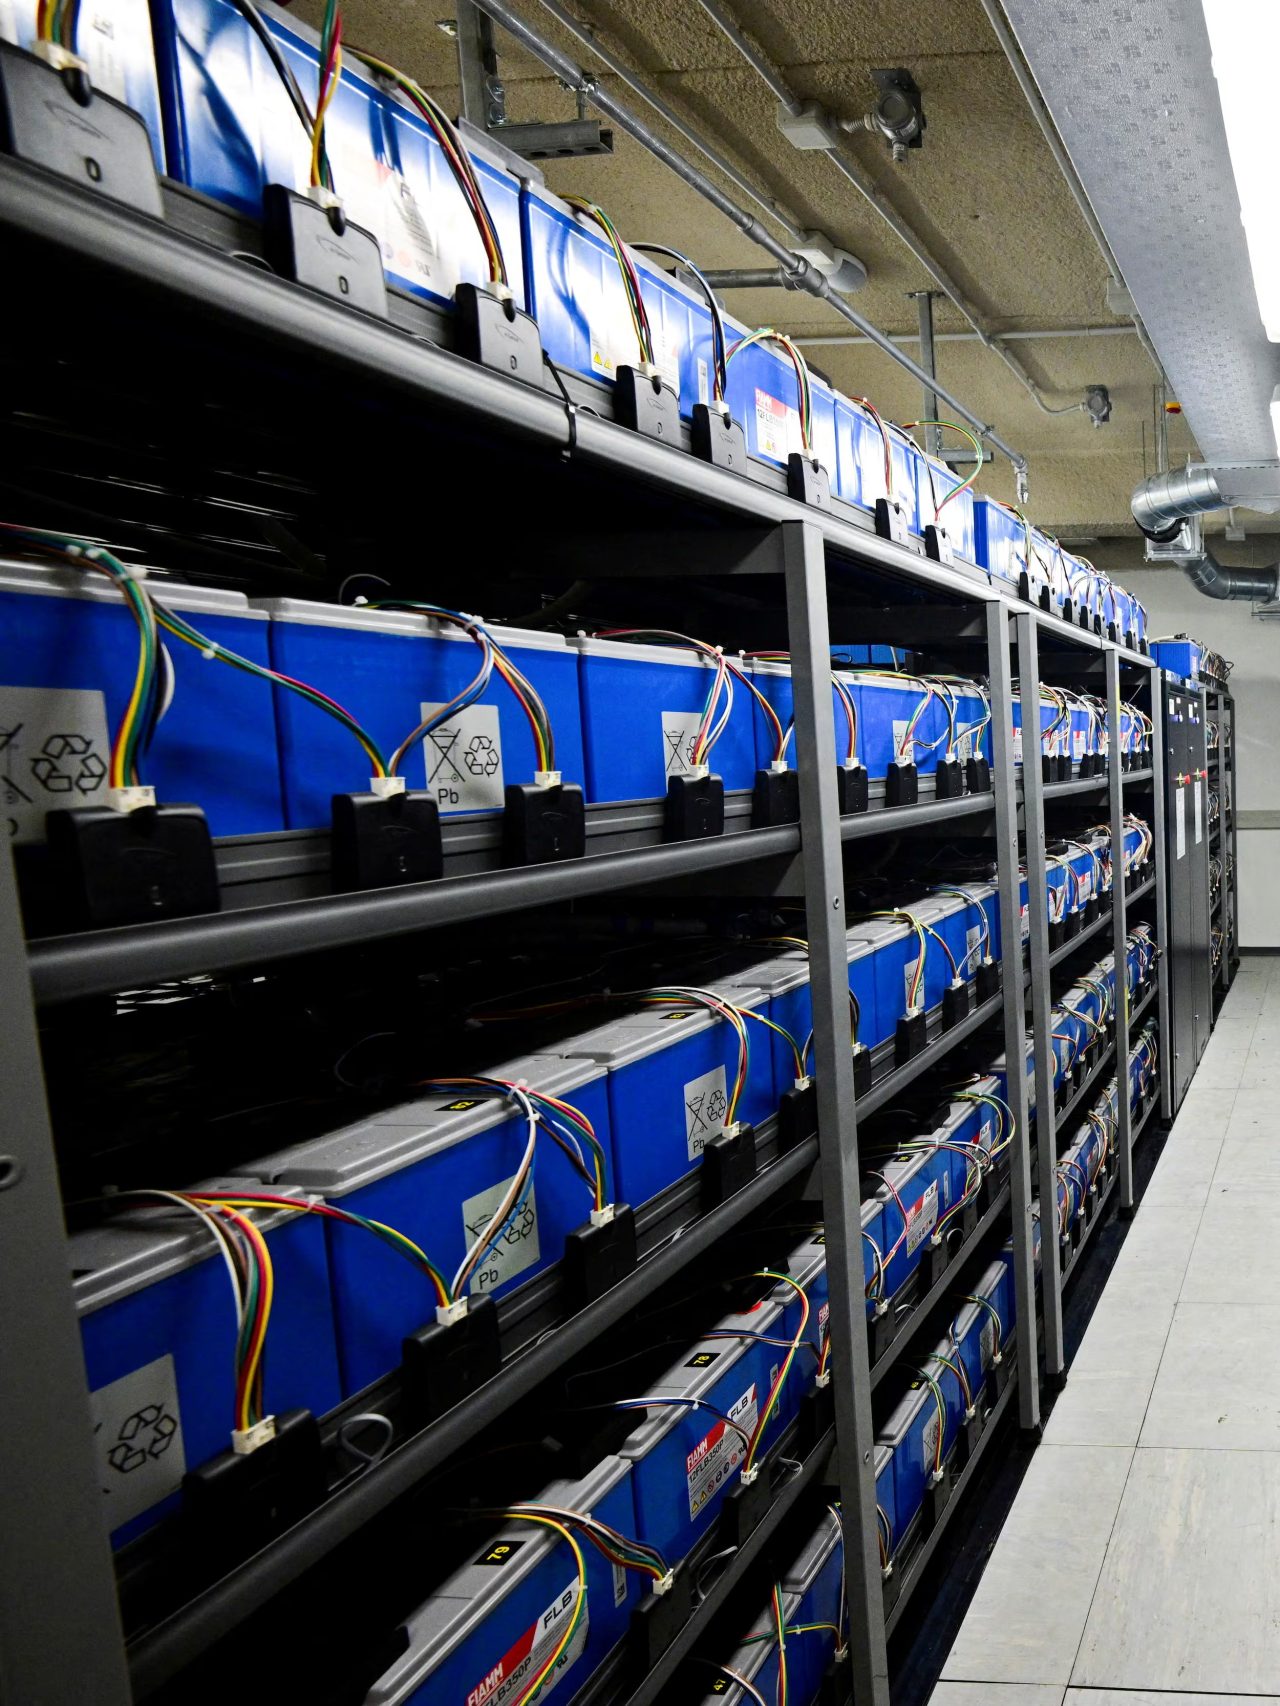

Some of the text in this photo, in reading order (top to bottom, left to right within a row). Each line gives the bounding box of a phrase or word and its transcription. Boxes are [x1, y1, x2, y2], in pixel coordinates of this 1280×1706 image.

[438, 788, 459, 804] Pb
[479, 1268, 499, 1290] Pb
[730, 1396, 749, 1420] FLB
[687, 1438, 708, 1471] FIAMM
[690, 1440, 724, 1483] 12FLB350P
[486, 1546, 510, 1560] 79
[543, 1590, 573, 1630] FLB
[713, 1679, 726, 1691] 47
